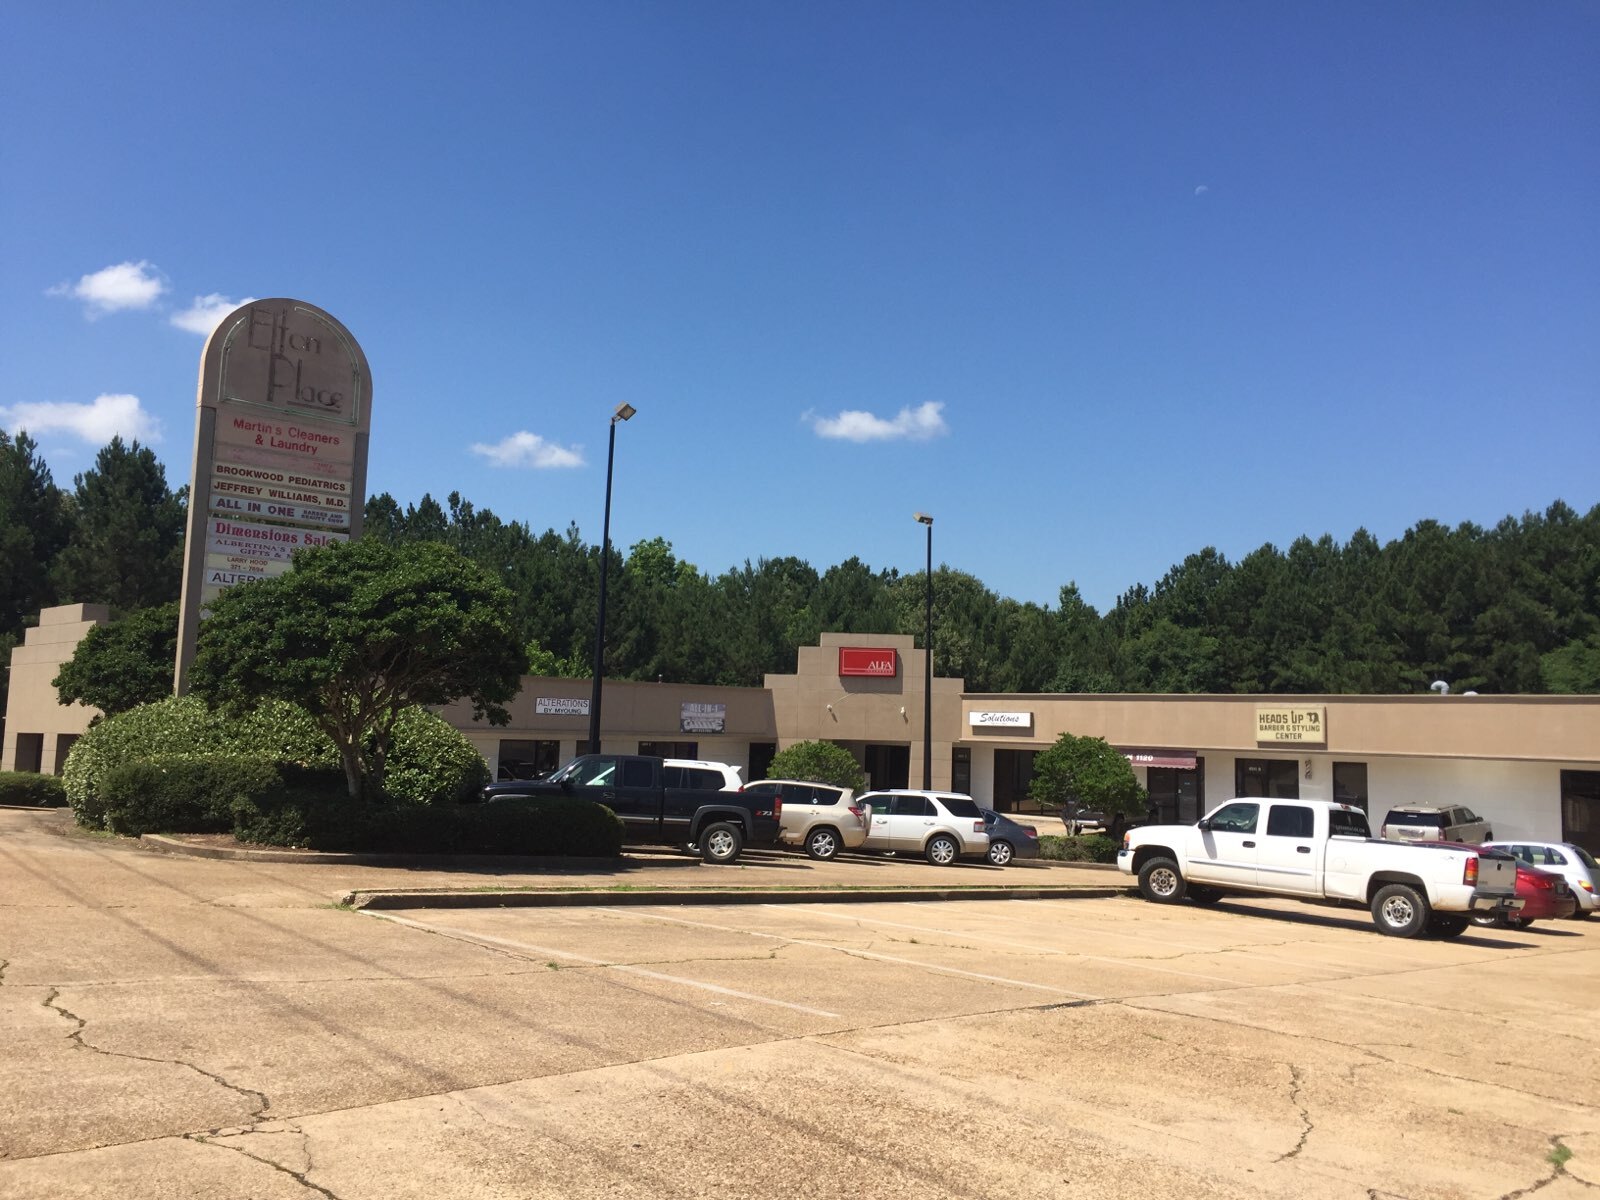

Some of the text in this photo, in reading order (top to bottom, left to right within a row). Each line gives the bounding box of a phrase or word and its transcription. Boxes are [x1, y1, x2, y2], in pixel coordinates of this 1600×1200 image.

[248, 306, 321, 354] Elton
[267, 353, 343, 408] Place
[288, 427, 340, 445] Cleaners
[255, 434, 318, 455] & Laundry
[216, 465, 346, 491] BROOKWOOD PEDIATRICS
[213, 481, 347, 508] JEFFREY WILLIAMS, M.D.
[216, 498, 295, 517] ALL IN ONE
[215, 522, 298, 544] Dimensions
[215, 539, 286, 553] ALBERTINA'S
[240, 548, 270, 557] GIFTS
[867, 660, 892, 670] ALFA
[538, 698, 588, 708] ALTERATIONS
[979, 713, 1020, 723] Solutions
[1259, 710, 1304, 724] HEADS UP
[1275, 732, 1303, 740] CENTER
[1135, 754, 1154, 762] 1120
